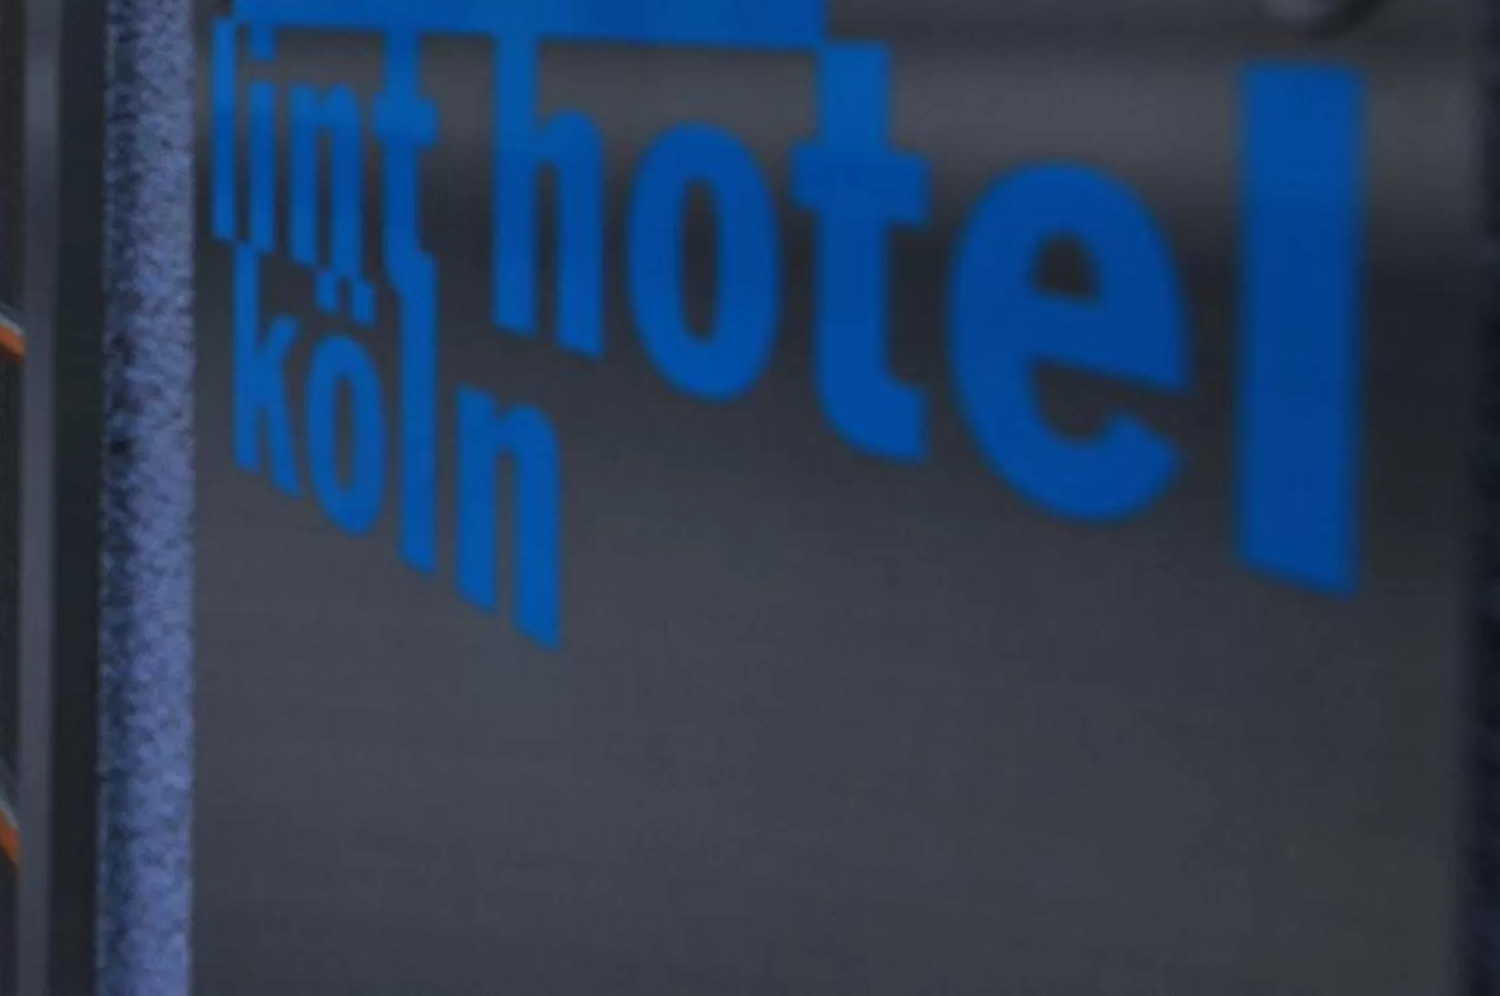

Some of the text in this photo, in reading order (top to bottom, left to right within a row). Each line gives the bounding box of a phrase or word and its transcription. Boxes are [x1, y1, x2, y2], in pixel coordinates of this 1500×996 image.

[211, 18, 1366, 595] lint hotel
[233, 243, 562, 650] köln
